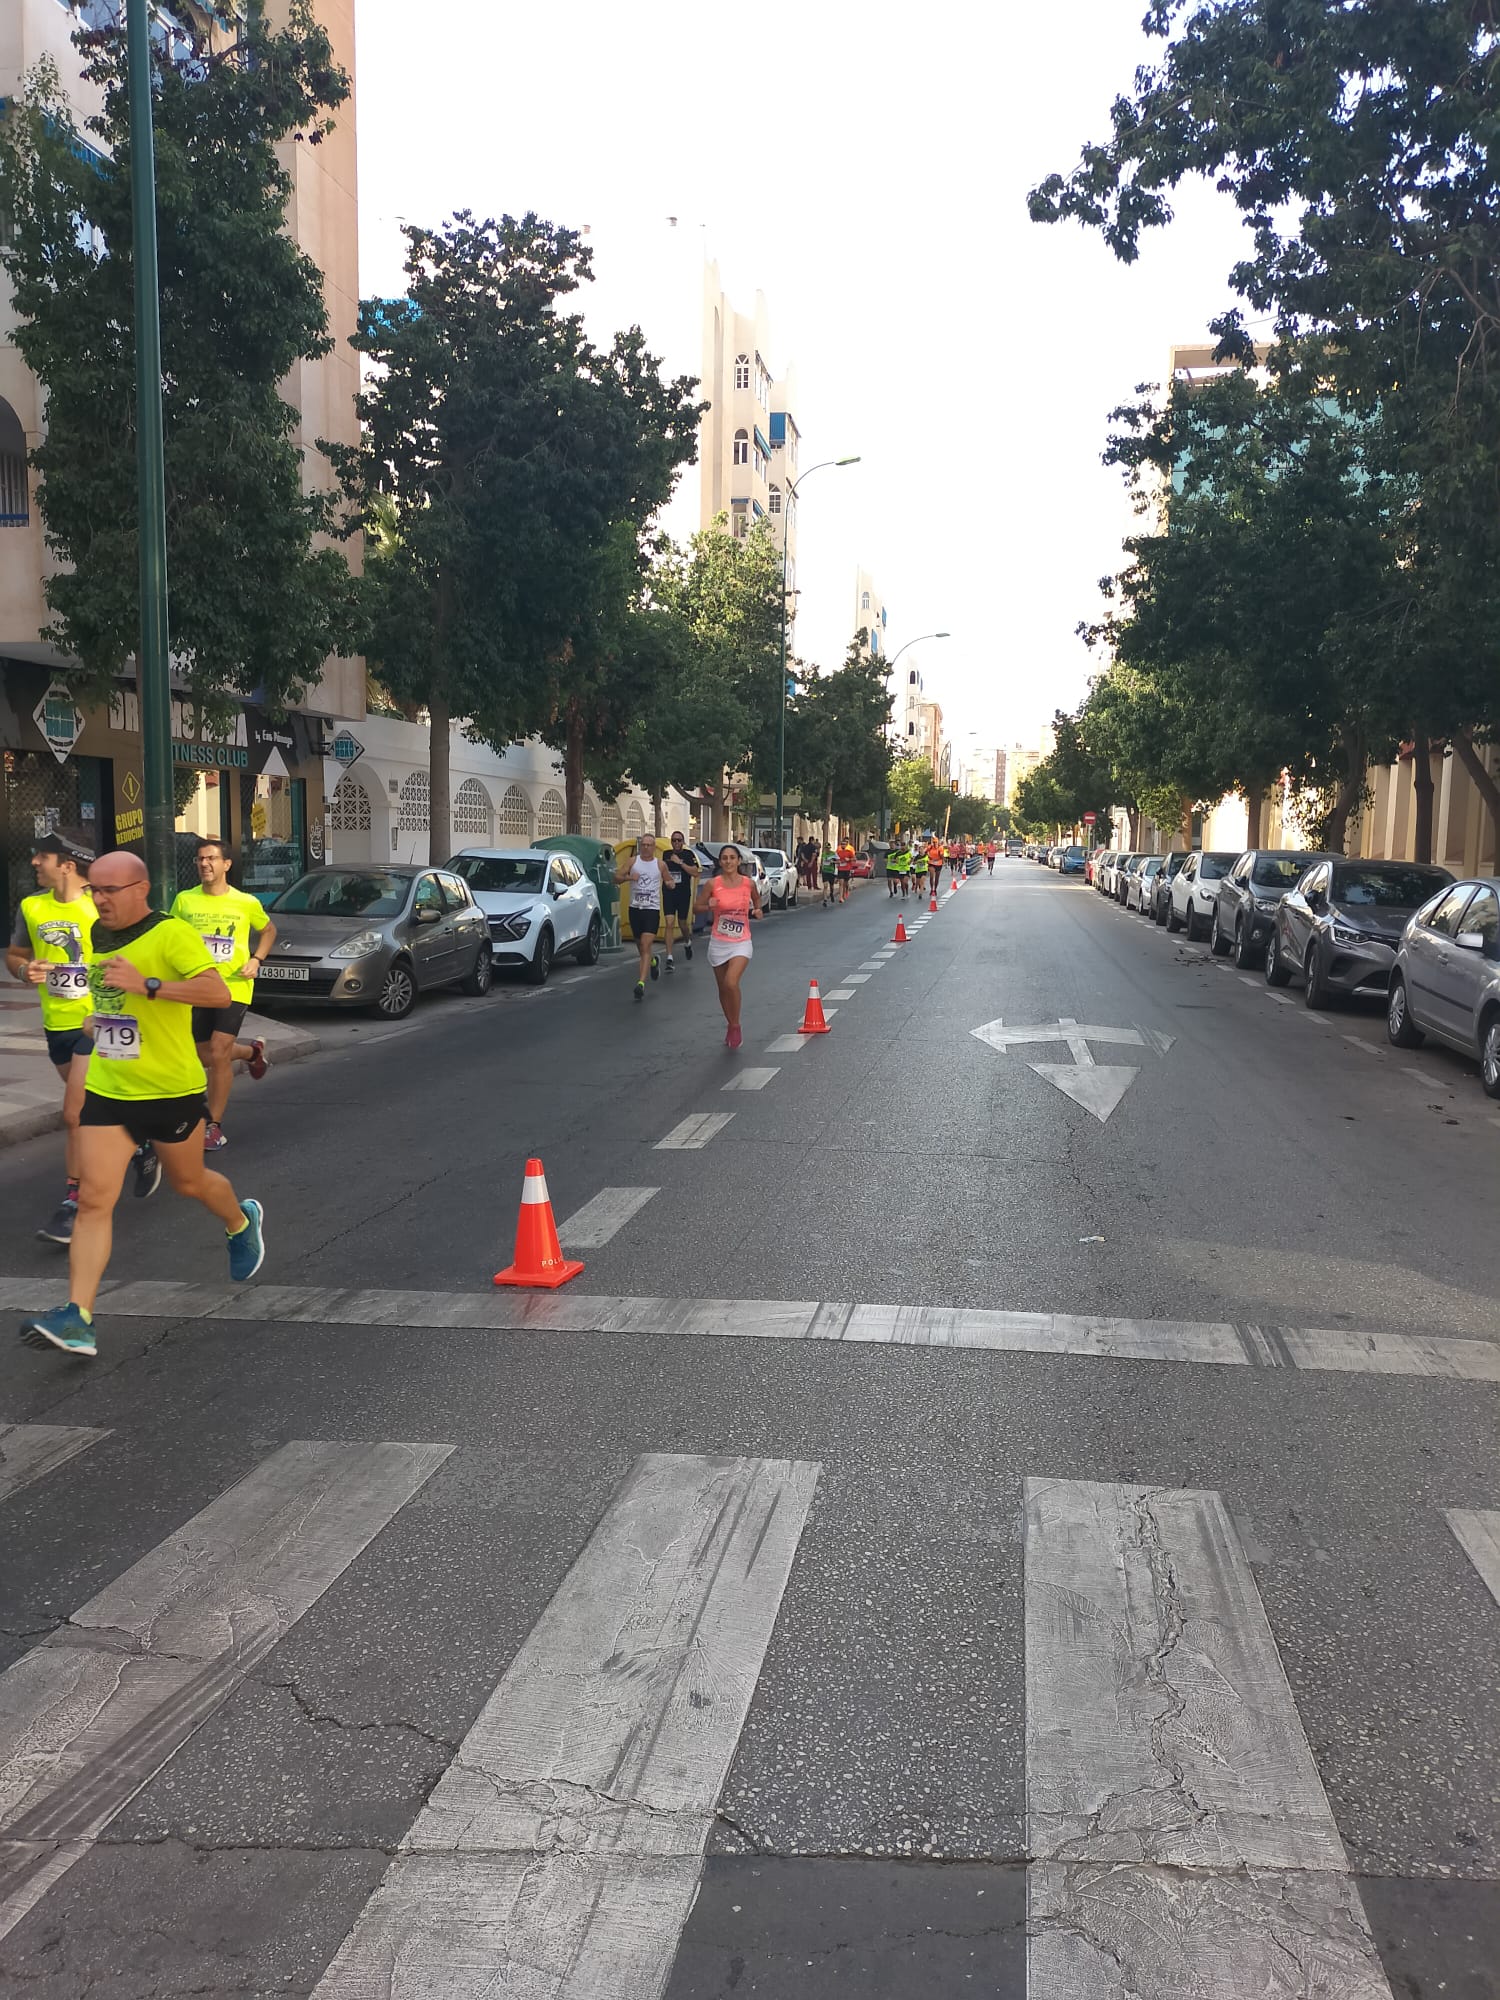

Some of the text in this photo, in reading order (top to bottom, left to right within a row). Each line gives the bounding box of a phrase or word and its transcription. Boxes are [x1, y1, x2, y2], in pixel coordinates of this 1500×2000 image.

[172, 743, 248, 768] TNESS CLUB
[115, 808, 144, 831] GRUPO
[721, 921, 743, 934] 590
[205, 941, 232, 955] 18
[49, 971, 87, 988] 326
[262, 967, 307, 979] 4830 HDT
[94, 1024, 135, 1046] 719
